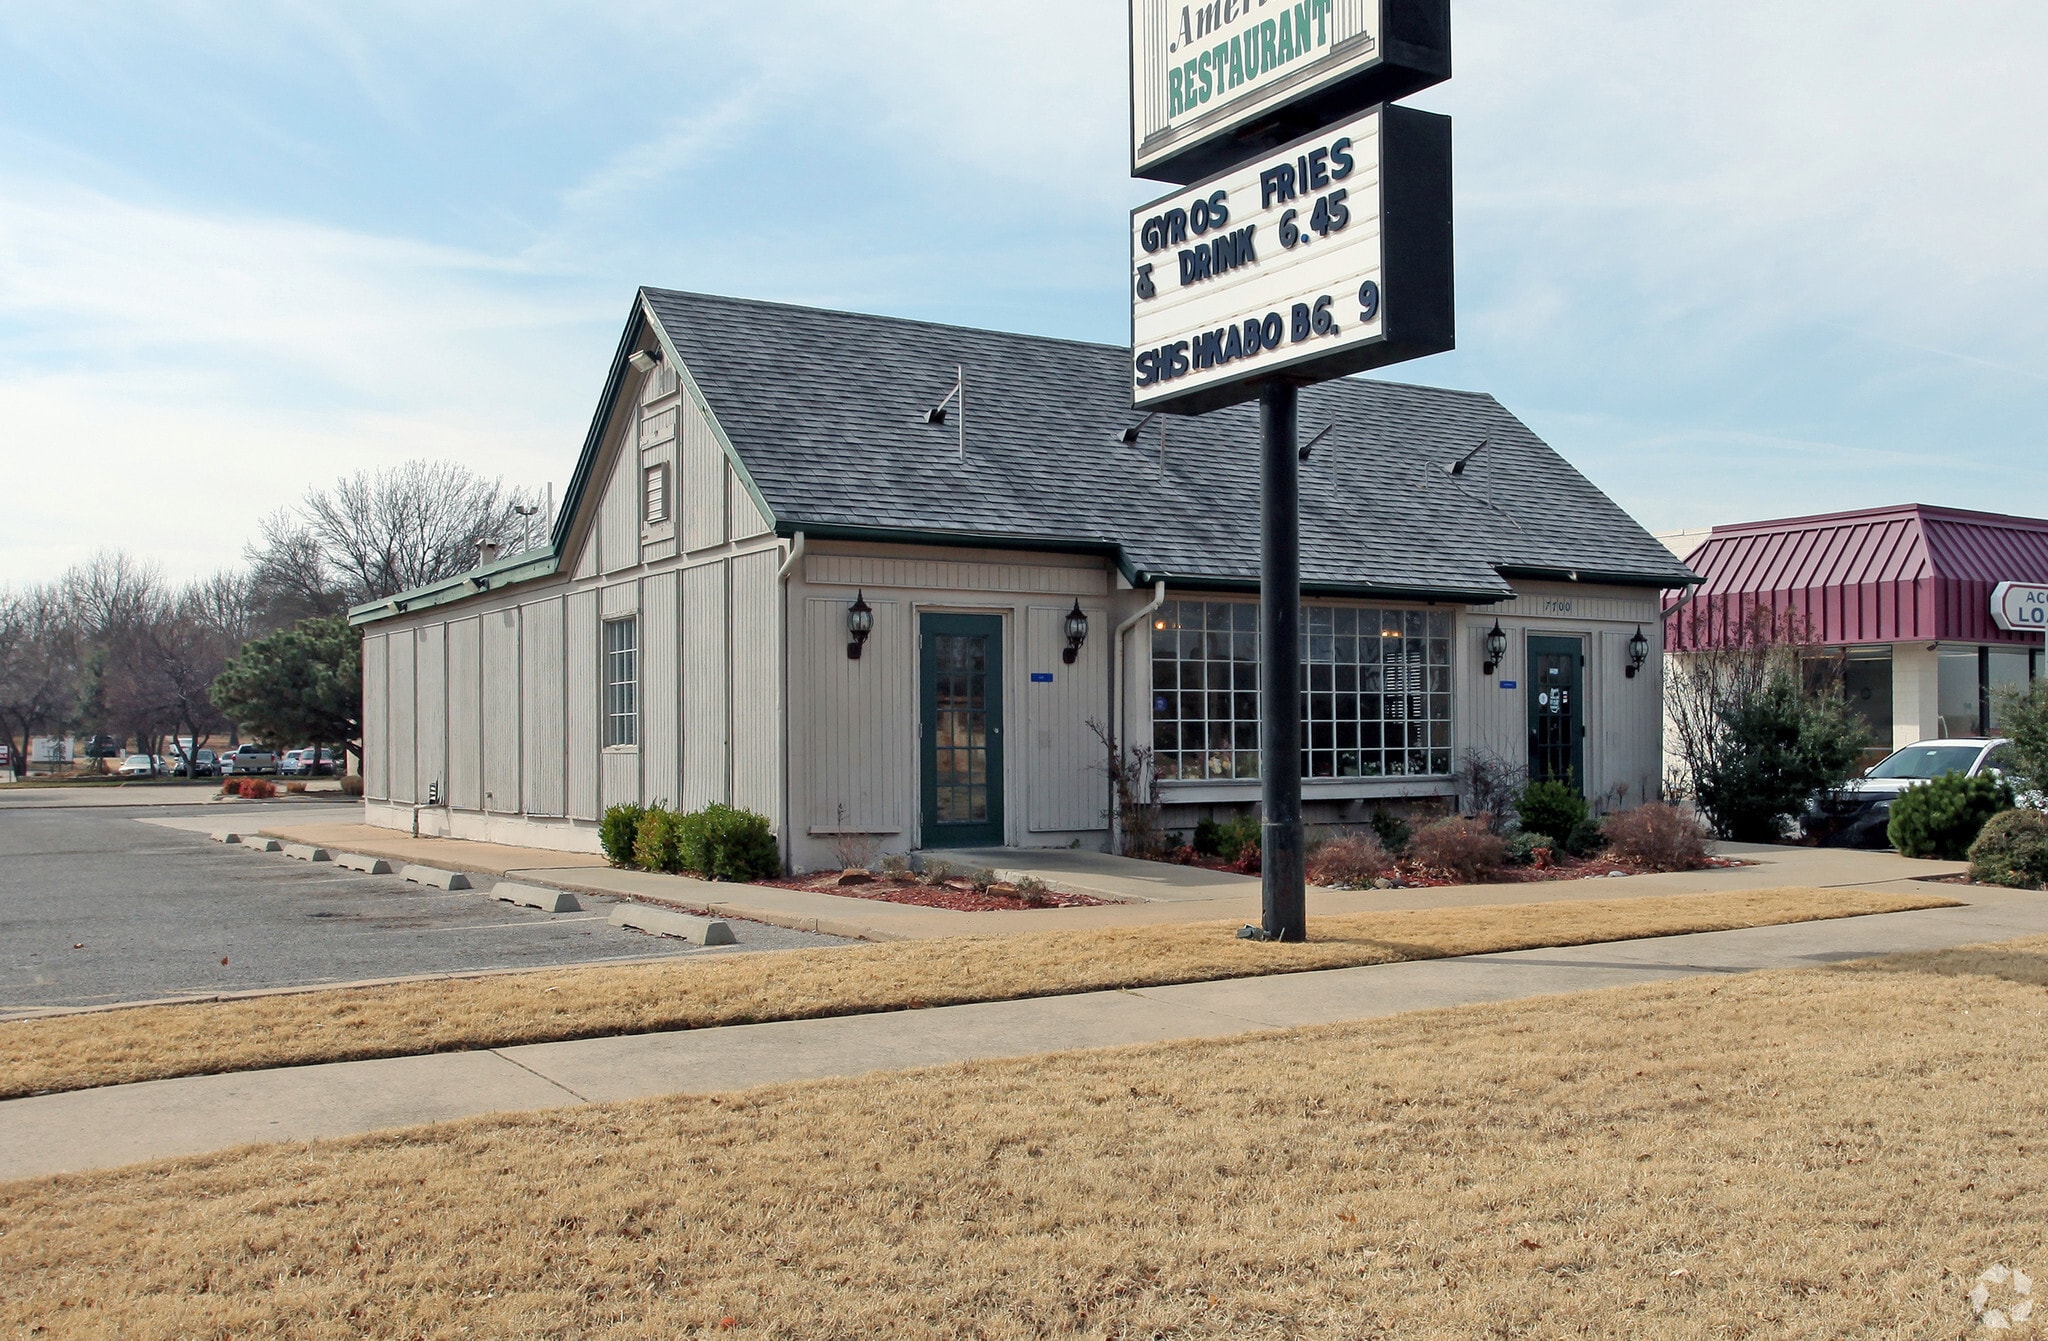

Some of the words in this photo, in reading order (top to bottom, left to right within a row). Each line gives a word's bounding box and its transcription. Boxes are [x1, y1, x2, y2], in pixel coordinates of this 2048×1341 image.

[1169, 0, 1268, 53] Amer
[1169, 0, 1331, 117] RESTAURANT
[1141, 190, 1228, 253] GYROS
[1260, 137, 1353, 209] FRIES
[1136, 263, 1156, 300] &
[1178, 224, 1256, 286] DRINK
[1279, 188, 1349, 249] 6.45
[1545, 601, 1571, 612] 7700
[2018, 607, 2048, 623] LO
[2026, 591, 2048, 604] AC
